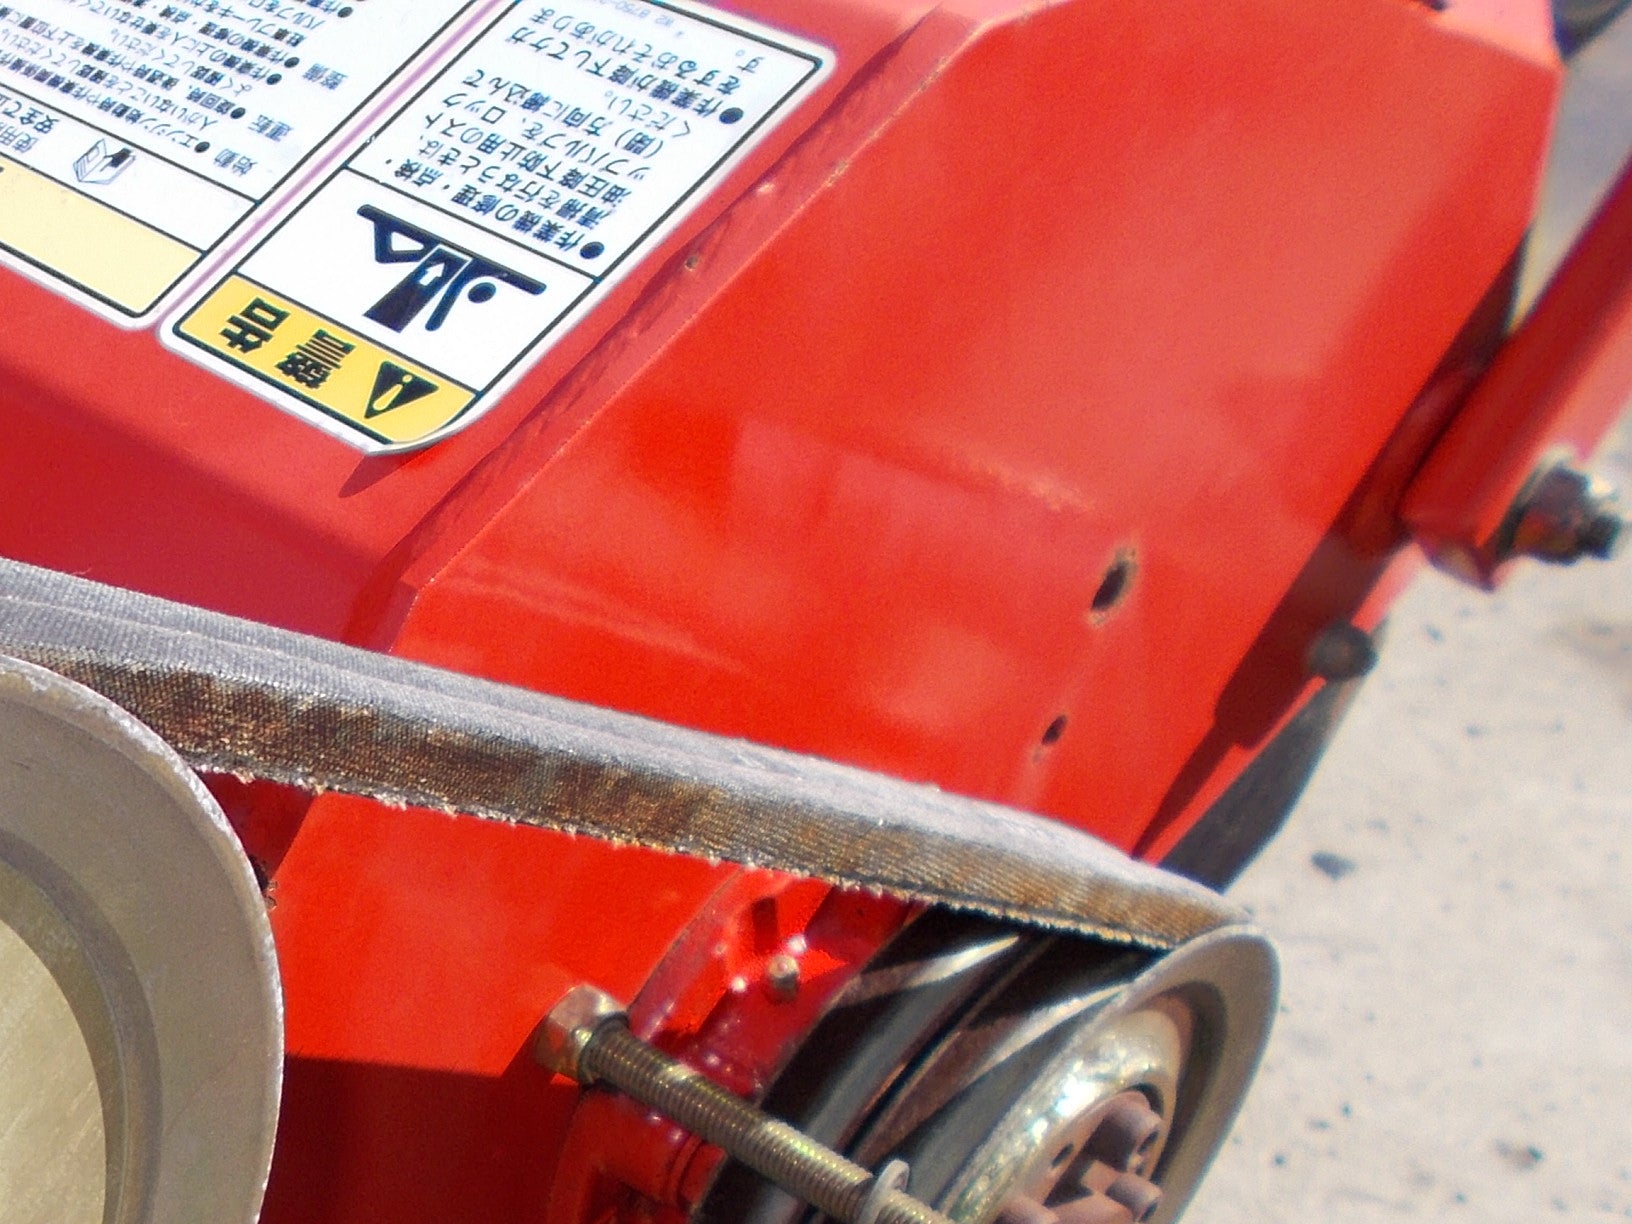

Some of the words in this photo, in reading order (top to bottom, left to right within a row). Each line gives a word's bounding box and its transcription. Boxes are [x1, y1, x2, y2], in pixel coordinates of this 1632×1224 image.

[303, 63, 347, 90] 整備
[506, 27, 723, 118] 作業機が降下してケガ
[530, 8, 740, 95] をするおそれがありま
[248, 115, 292, 141] 運転
[604, 91, 690, 138] ください。
[214, 149, 257, 176] 始動
[425, 113, 631, 207] 油圧降下防止用のスト
[217, 296, 357, 389] 警告
